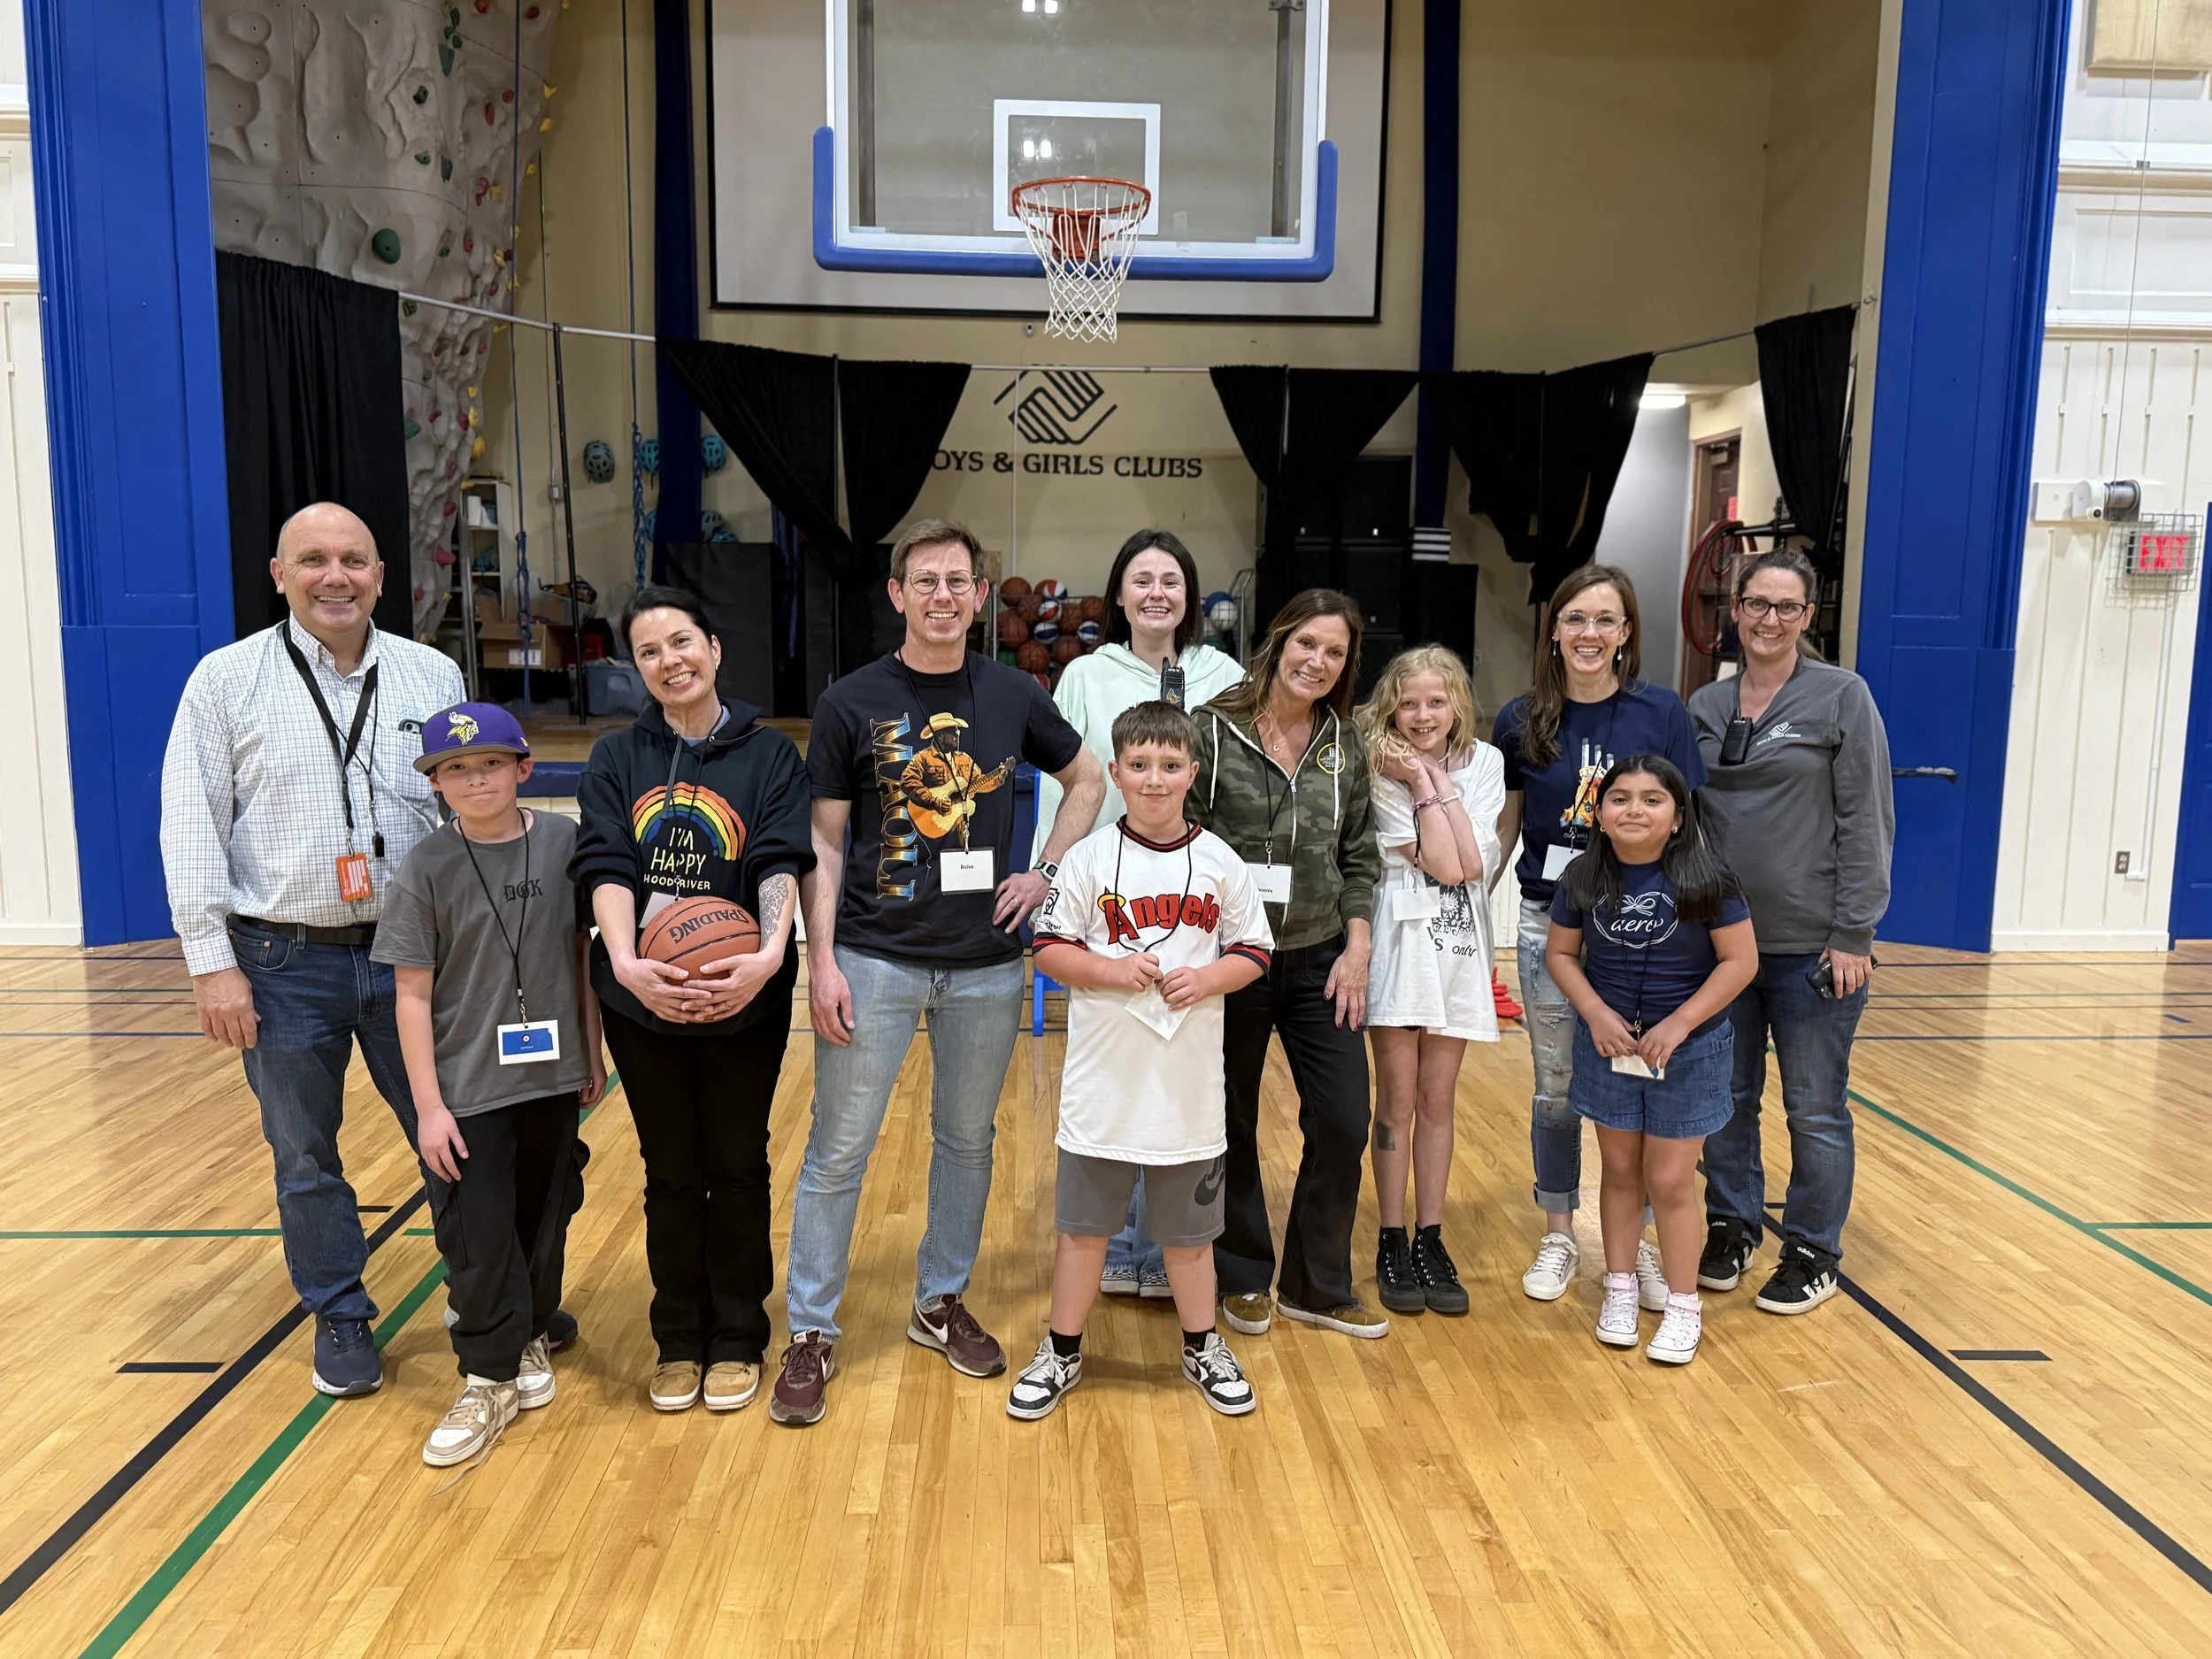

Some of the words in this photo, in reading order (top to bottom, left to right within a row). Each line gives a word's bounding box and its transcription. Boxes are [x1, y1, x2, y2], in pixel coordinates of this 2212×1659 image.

[932, 449, 984, 472] OYS
[993, 451, 1013, 472] &
[1023, 452, 1104, 475] GIRLS
[1114, 456, 1203, 479] CLUBS
[2139, 534, 2190, 570] EXIT
[669, 826, 694, 851] I'M
[650, 846, 707, 875] HAPPY
[643, 873, 674, 887] HOOD
[679, 879, 710, 890] RIVER
[667, 909, 749, 945] SPALDING
[1098, 887, 1220, 945] Angels
[1610, 918, 1664, 933] aero
[1452, 944, 1477, 957] only
[1796, 1246, 1816, 1259] adidas
